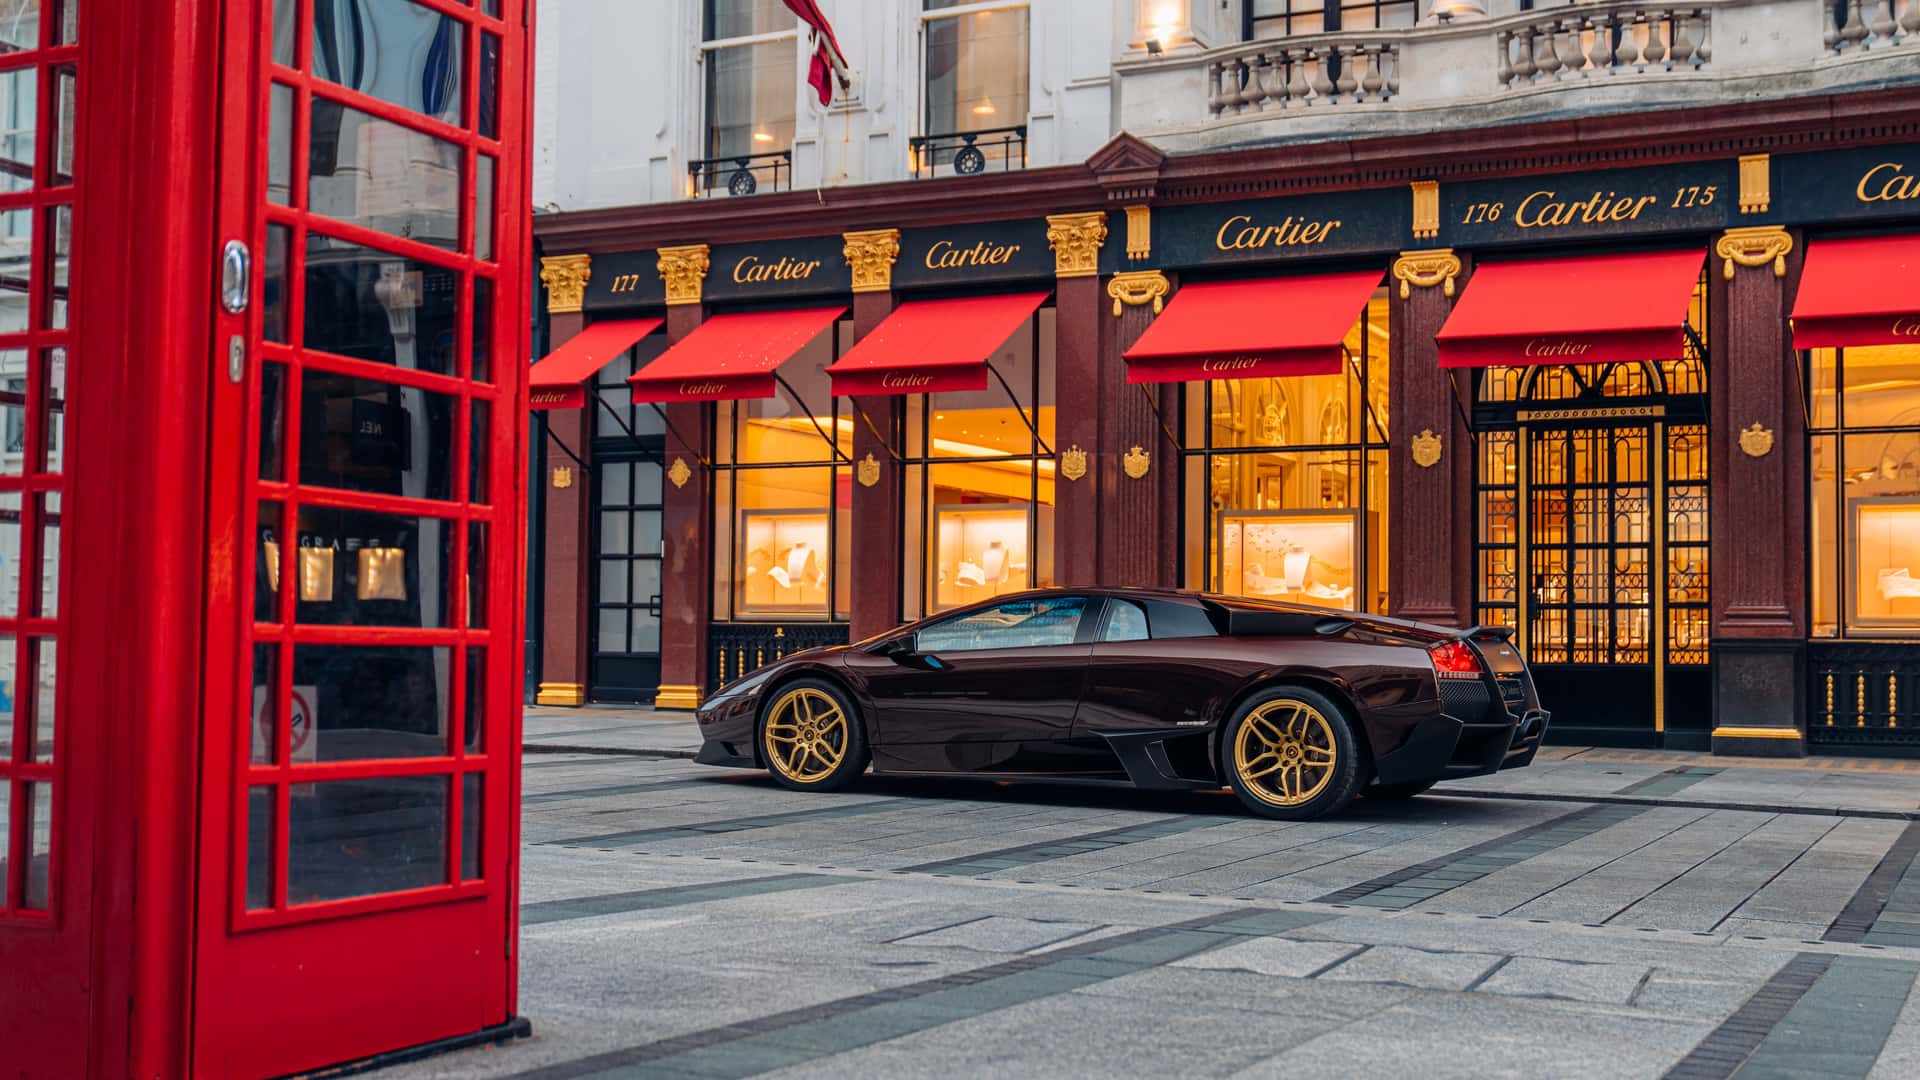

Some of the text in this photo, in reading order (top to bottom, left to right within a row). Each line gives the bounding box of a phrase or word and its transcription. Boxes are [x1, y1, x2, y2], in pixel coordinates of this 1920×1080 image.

[1462, 185, 1719, 228] 176 Cartier 175
[1216, 215, 1342, 251] Cartier
[926, 240, 1021, 269] Cartier
[733, 255, 821, 285] Cartier
[610, 274, 640, 293] 177
[1525, 339, 1593, 358] Cartier
[1201, 354, 1262, 373] Cartier
[679, 381, 728, 395] Cartier
[882, 372, 934, 388] Cartier
[530, 391, 568, 403] artier
